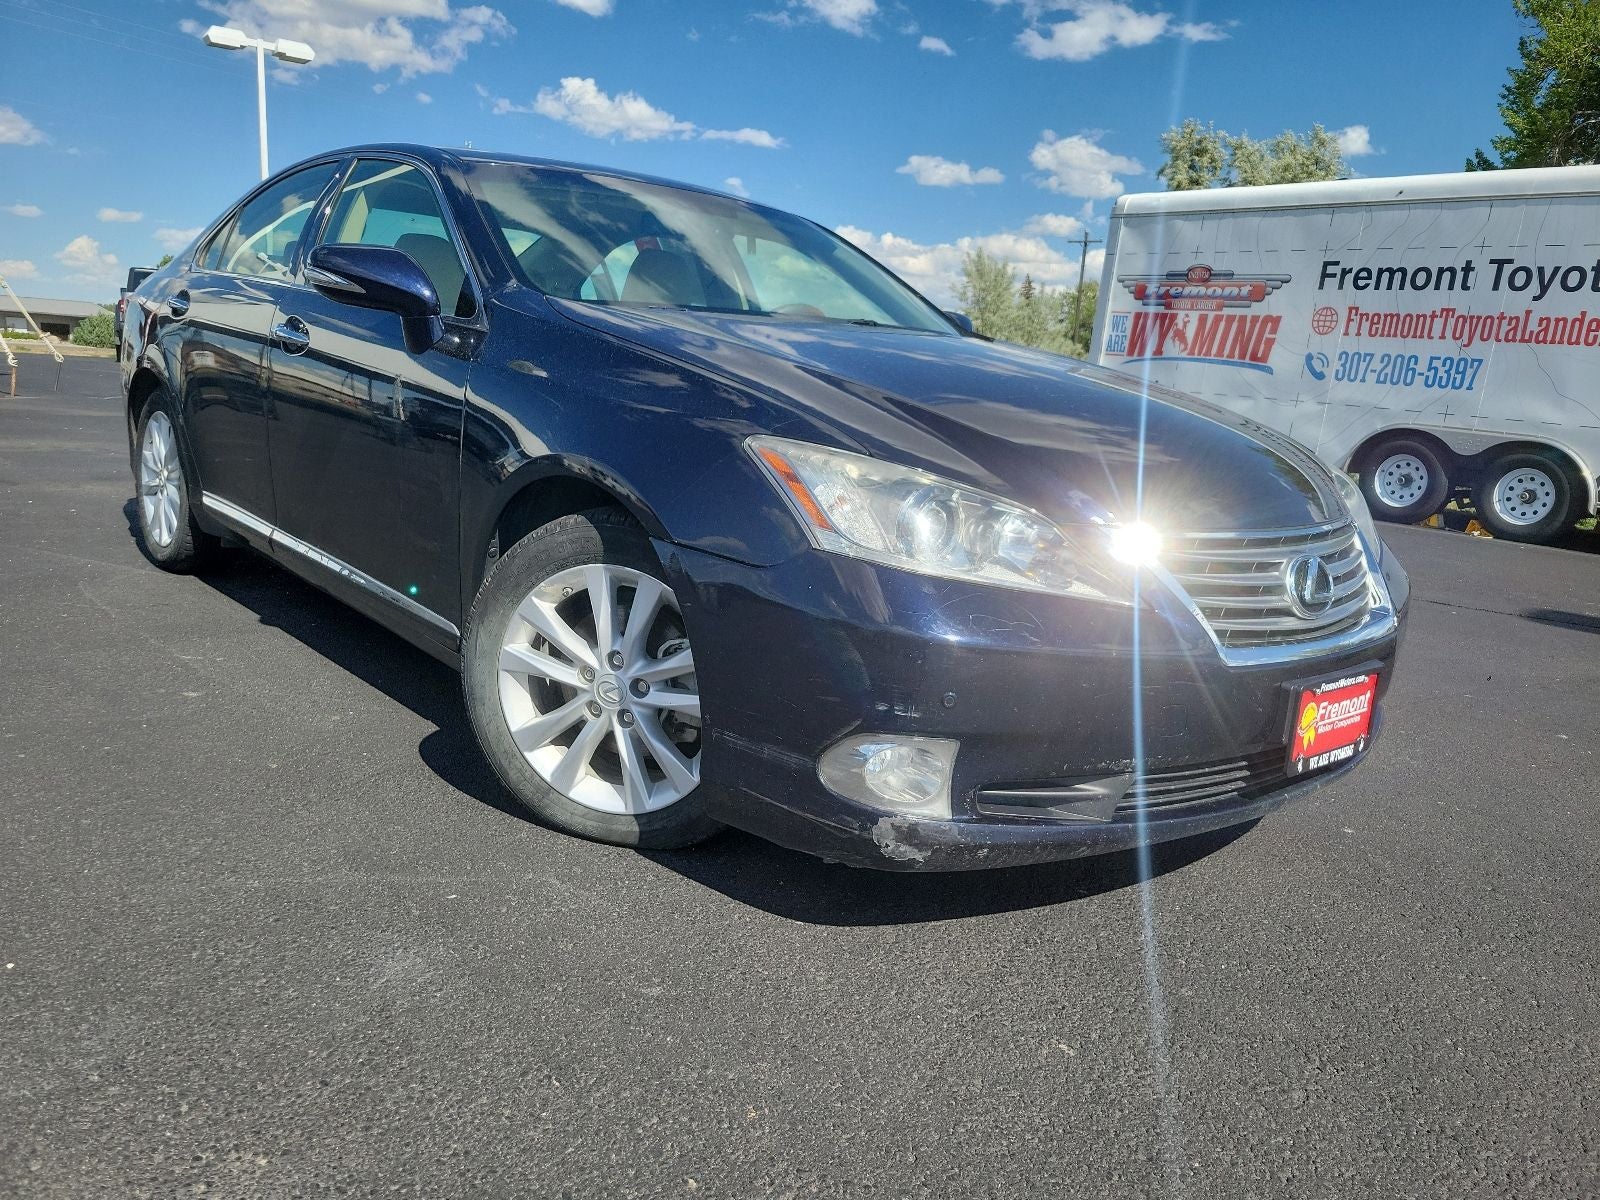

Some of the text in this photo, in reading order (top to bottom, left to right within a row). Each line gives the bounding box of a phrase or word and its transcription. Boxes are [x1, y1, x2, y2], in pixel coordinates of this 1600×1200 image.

[1318, 260, 1475, 291] Fremont
[1145, 283, 1253, 298] Fremont
[1111, 315, 1127, 332] WE
[1343, 306, 1600, 348] FremontToyotaLande
[1106, 334, 1126, 353] ARE
[1335, 351, 1484, 391] 307-206-5397
[1317, 690, 1370, 720] Fremont
[1309, 756, 1320, 770] WE
